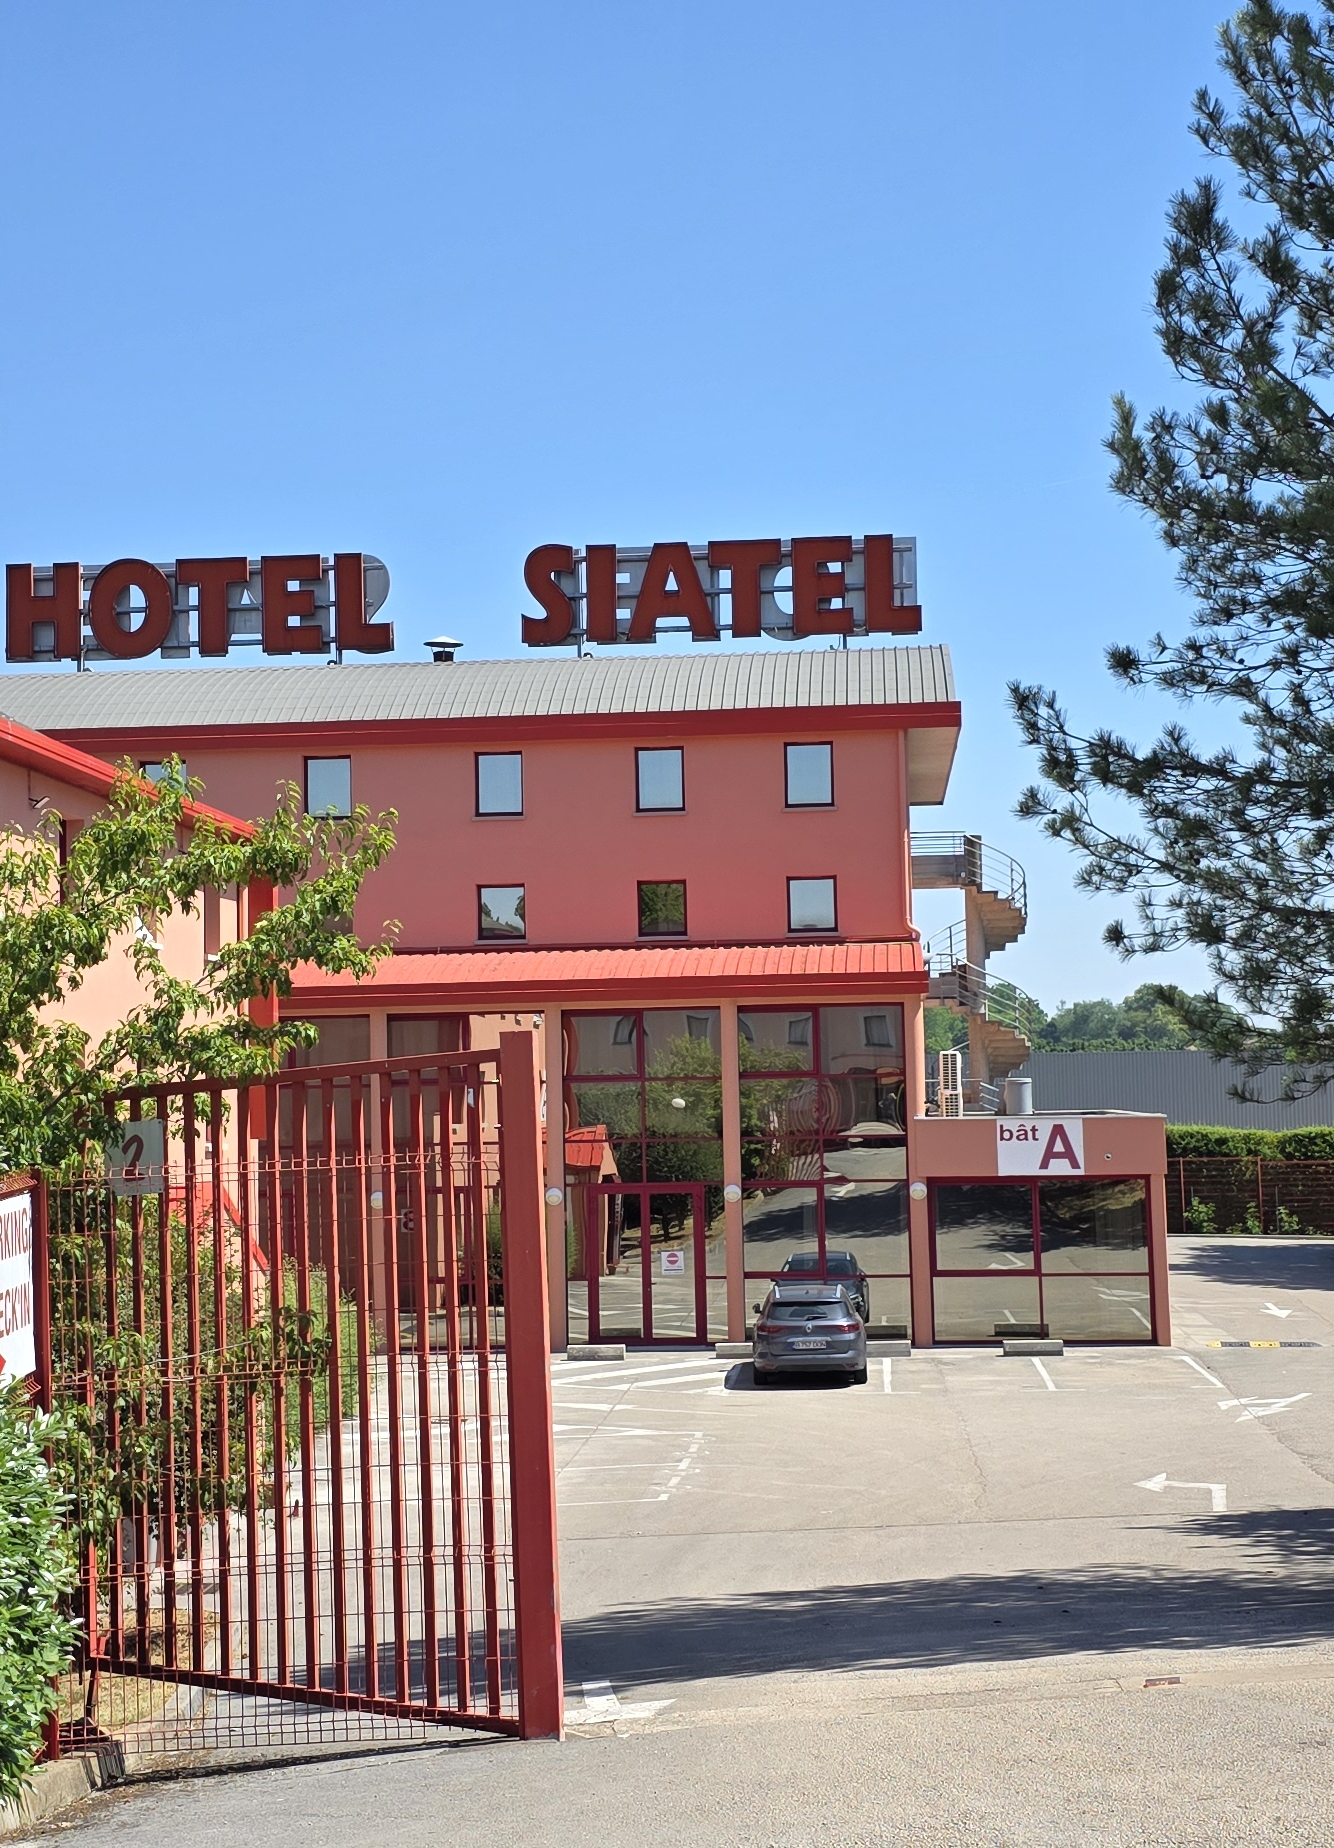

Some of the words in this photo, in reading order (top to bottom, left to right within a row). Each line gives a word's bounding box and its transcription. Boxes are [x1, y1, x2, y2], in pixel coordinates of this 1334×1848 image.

[5, 553, 395, 660] HOTEL
[521, 534, 923, 645] SIATEL
[121, 1134, 147, 1183] 2
[999, 1124, 1039, 1142] bât
[1038, 1123, 1081, 1170] A
